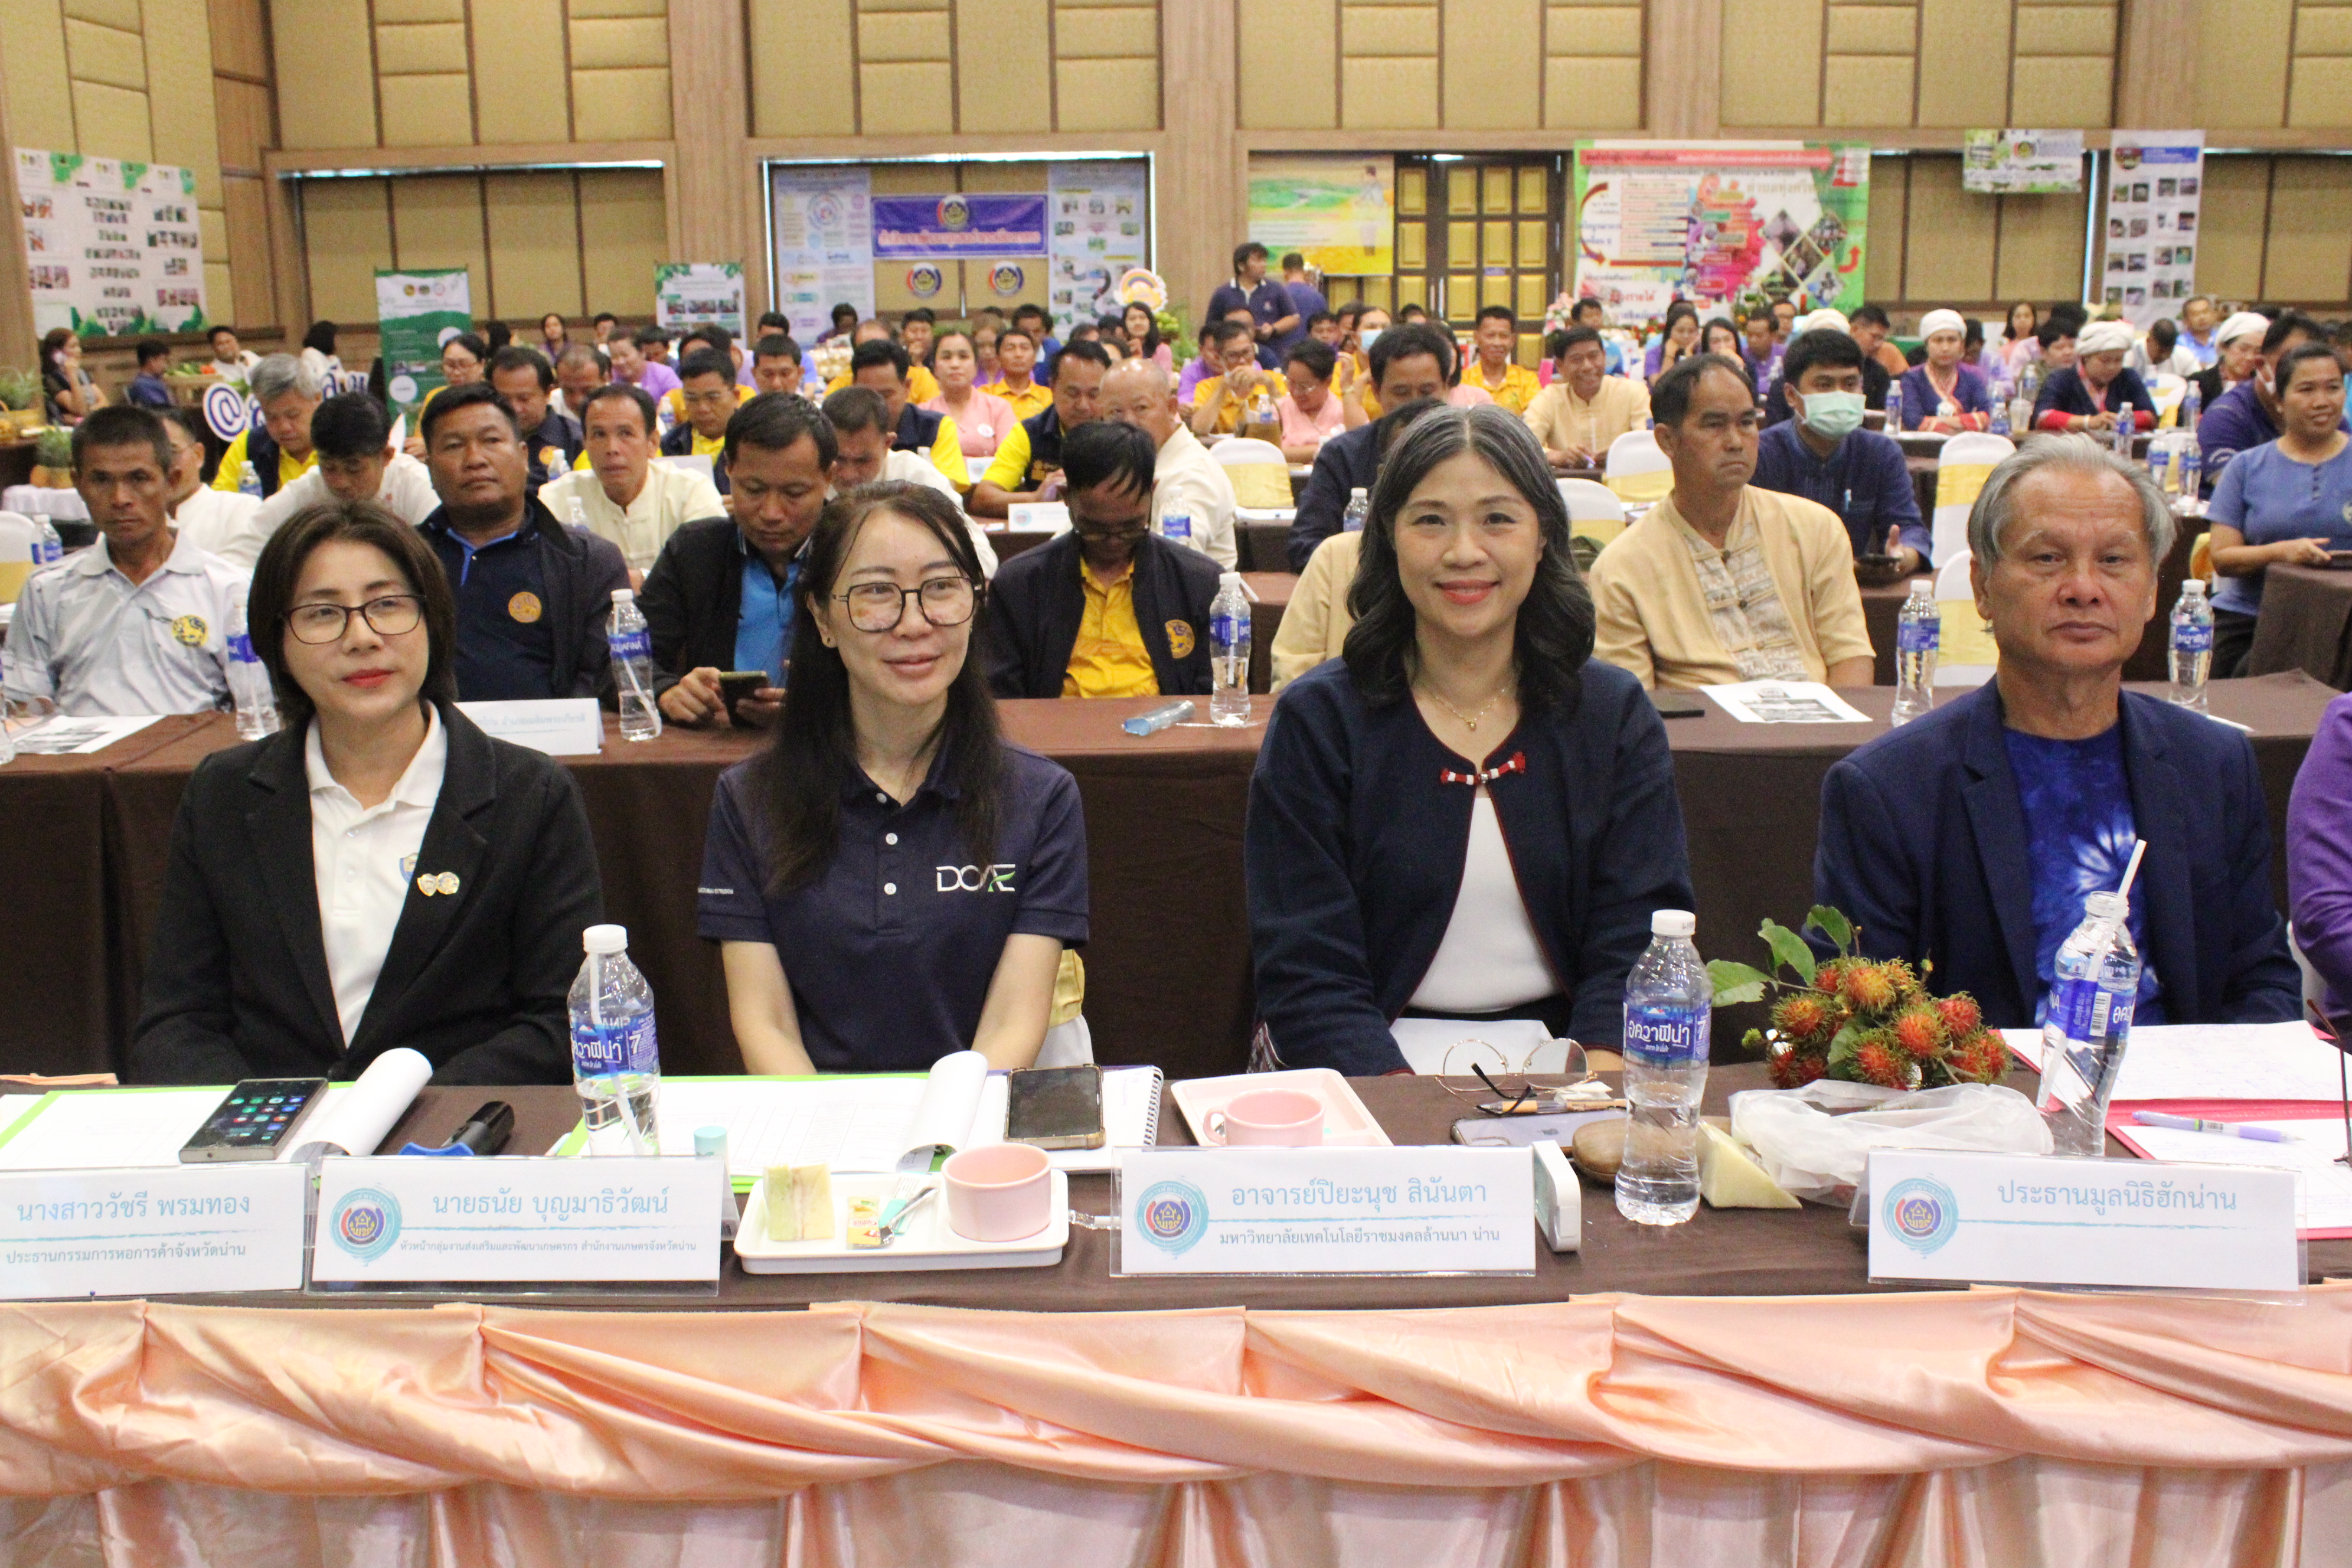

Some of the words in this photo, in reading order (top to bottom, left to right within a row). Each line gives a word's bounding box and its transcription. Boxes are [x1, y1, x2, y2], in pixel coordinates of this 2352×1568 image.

[1628, 1020, 1690, 1046] อควาฟีน่า
[18, 1191, 148, 1221] นางสาววัชรี
[158, 1197, 250, 1216] พรมทอง
[433, 1187, 522, 1214] นายธนัย
[533, 1186, 669, 1222] บุญมาธิวัฒน์
[1232, 1177, 1397, 1213] อาจารย์ปิยะนุช
[1408, 1176, 1487, 1203] สินันตา
[1998, 1180, 2236, 1216] ประธานมูลนิธิฮักน่าน
[582, 1239, 697, 1251] สำนักงานเกษตรจังหวัดน่าน
[1220, 1227, 1467, 1244] มหาวิทยาลัยเทคโนโลยีราชมงคลล้านนา
[1473, 1226, 1500, 1241] น่าน
[6, 1242, 246, 1265] ประธานกรรมการหอการค้าจังหวัดน่าน
